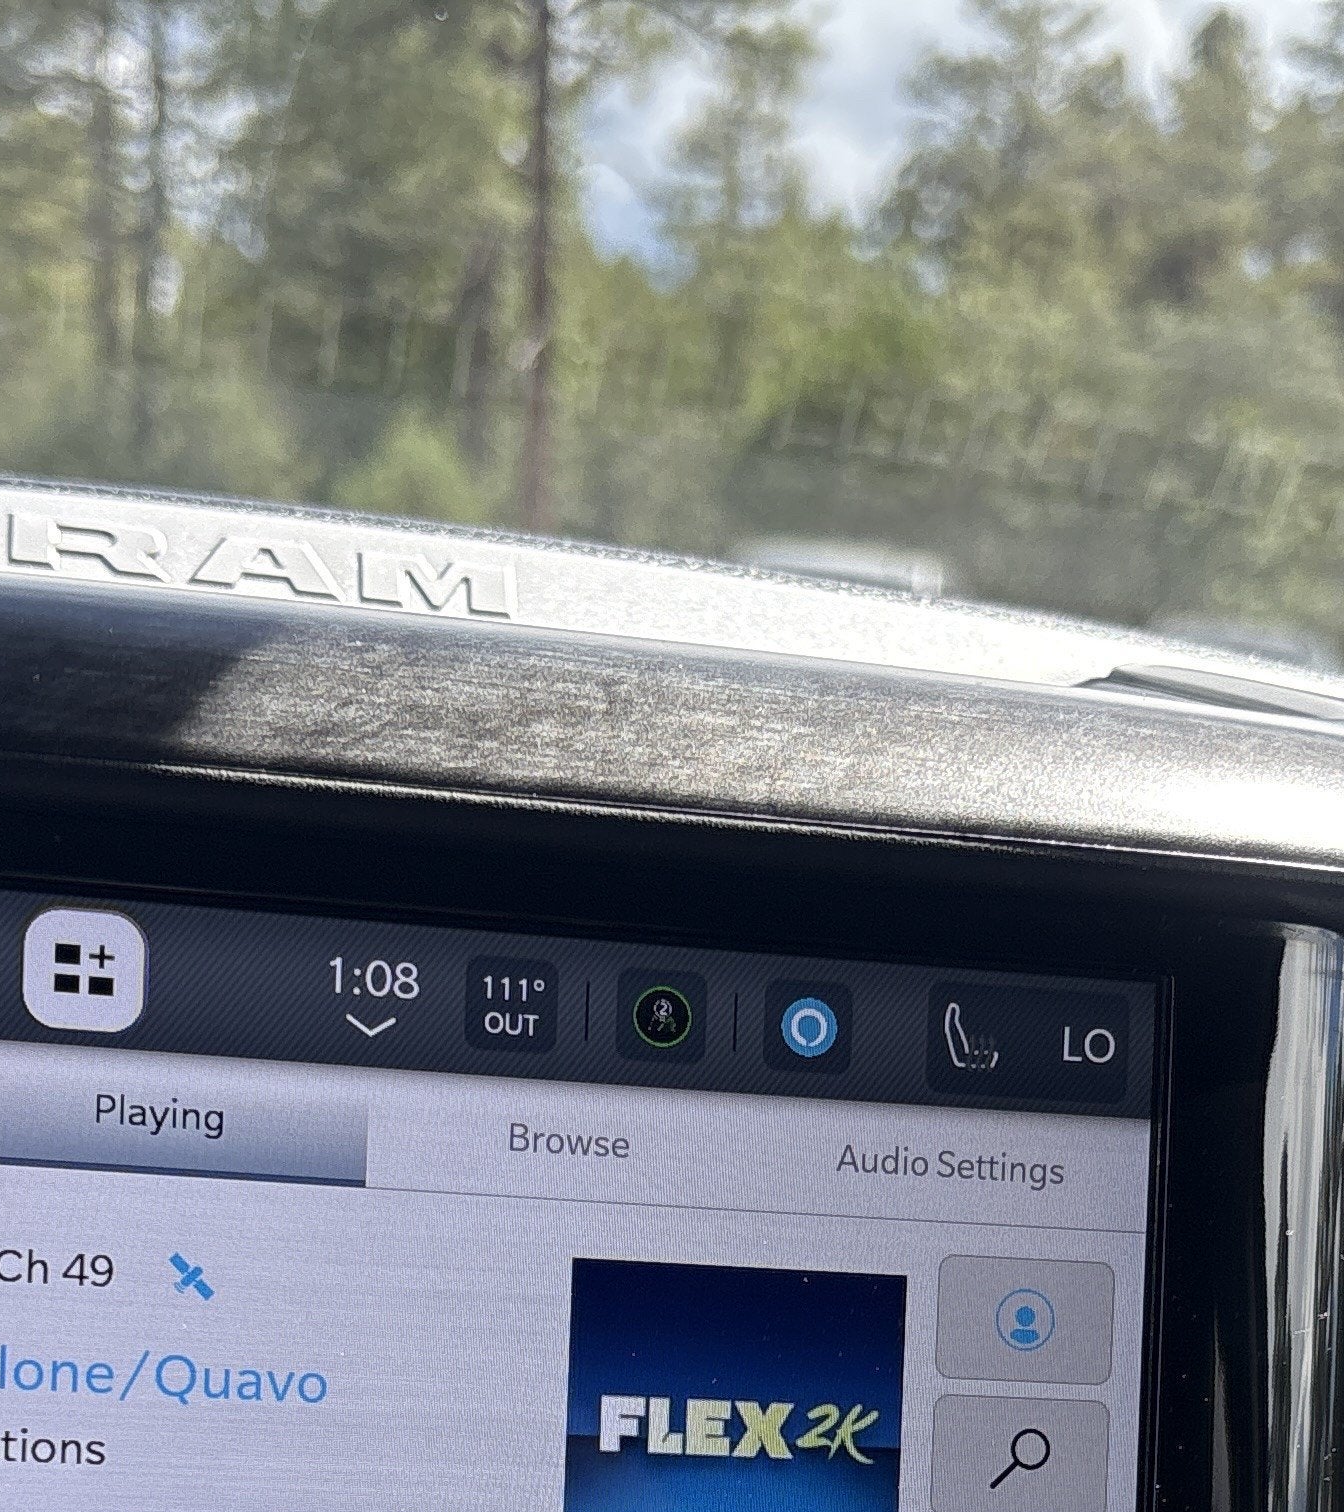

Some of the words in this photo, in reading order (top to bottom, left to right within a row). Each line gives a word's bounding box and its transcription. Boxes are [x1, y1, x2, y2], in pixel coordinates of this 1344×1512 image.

[7, 512, 517, 619] RAM
[329, 956, 420, 1000] 1:08
[484, 1011, 540, 1037] OUT
[1063, 1026, 1116, 1064] LO
[95, 1093, 224, 1140] Playing
[509, 1122, 630, 1159] Browse
[836, 1143, 929, 1177] Audio
[936, 1150, 1065, 1192] Settings
[61, 1253, 114, 1288] 49
[598, 1394, 795, 1461] FLEX
[796, 1403, 880, 1465] 2K
